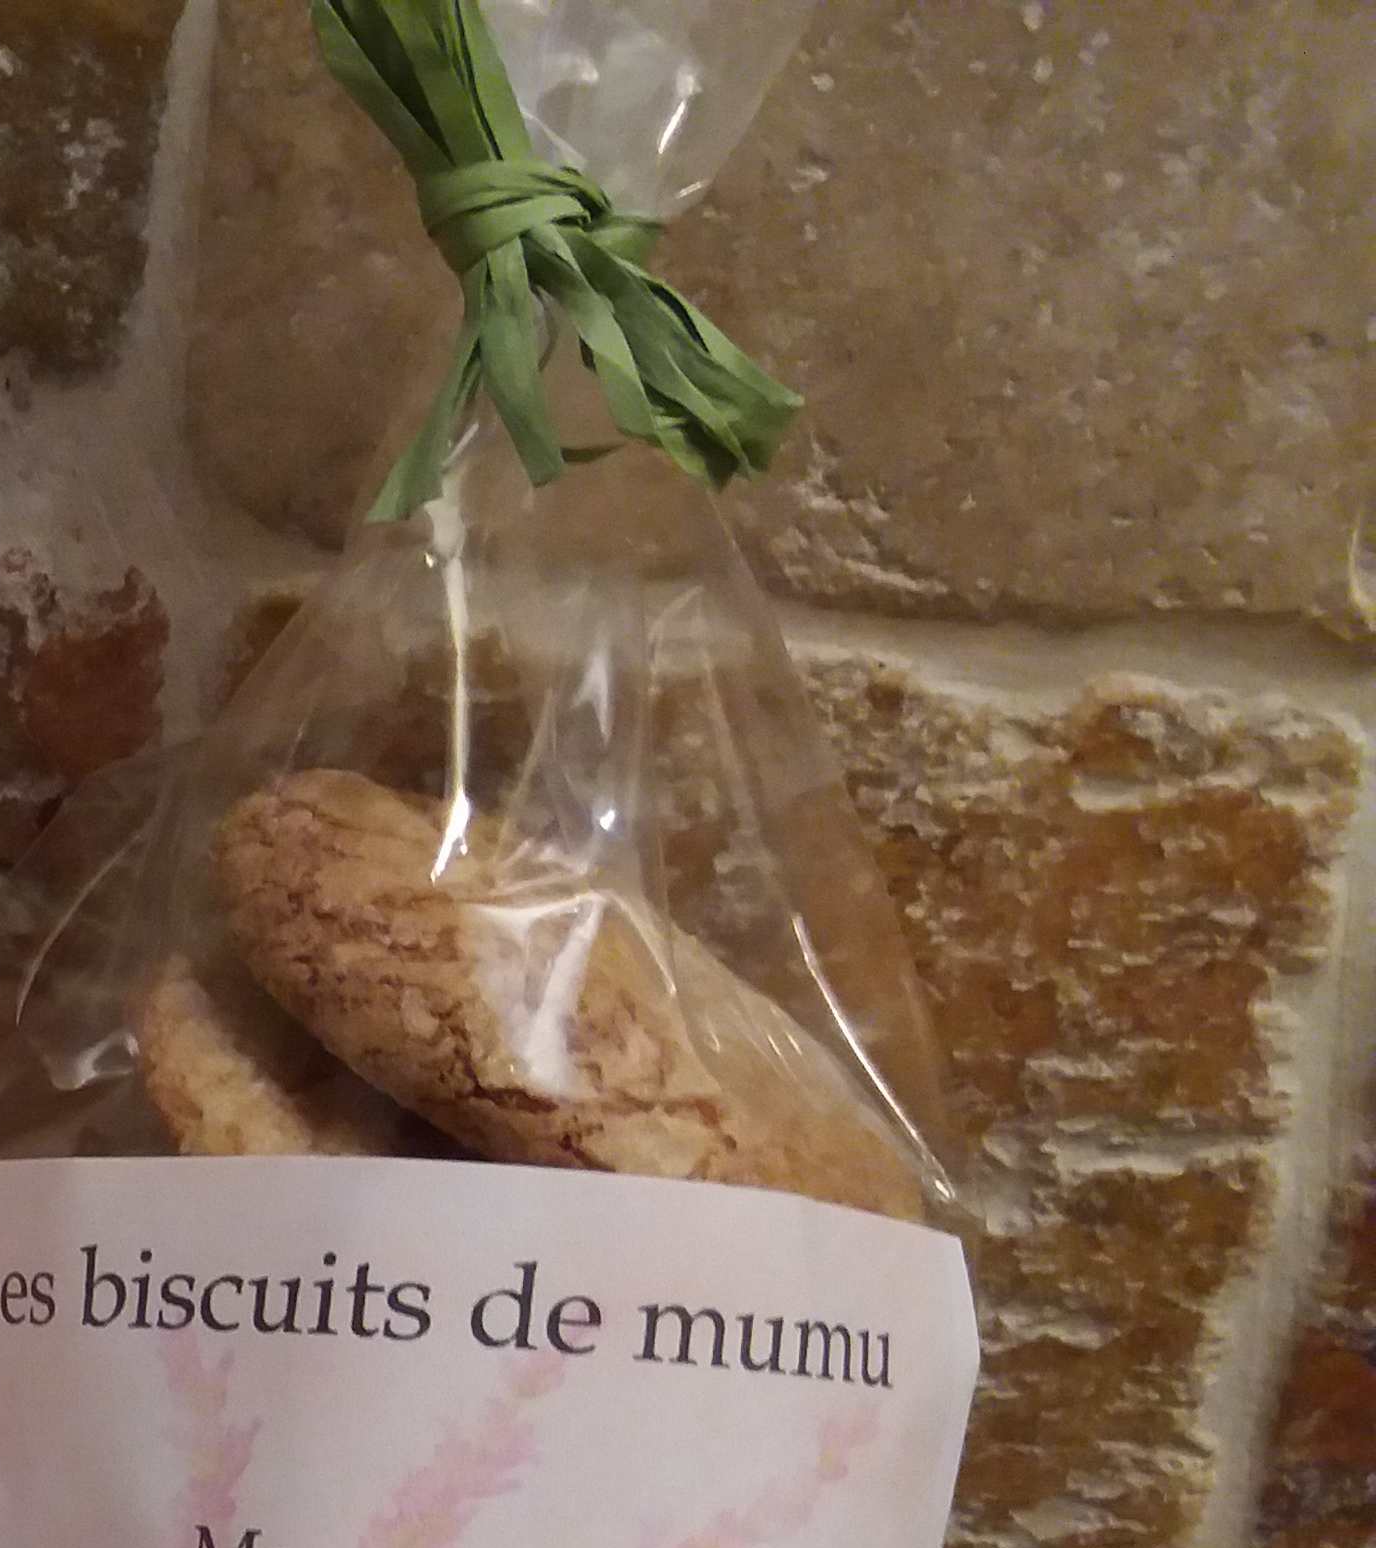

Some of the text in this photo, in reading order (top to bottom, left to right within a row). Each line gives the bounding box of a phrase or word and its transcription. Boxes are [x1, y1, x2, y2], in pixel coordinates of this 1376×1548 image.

[81, 1244, 430, 1340] biscuits
[471, 1261, 601, 1354] de
[640, 1304, 890, 1387] mumu
